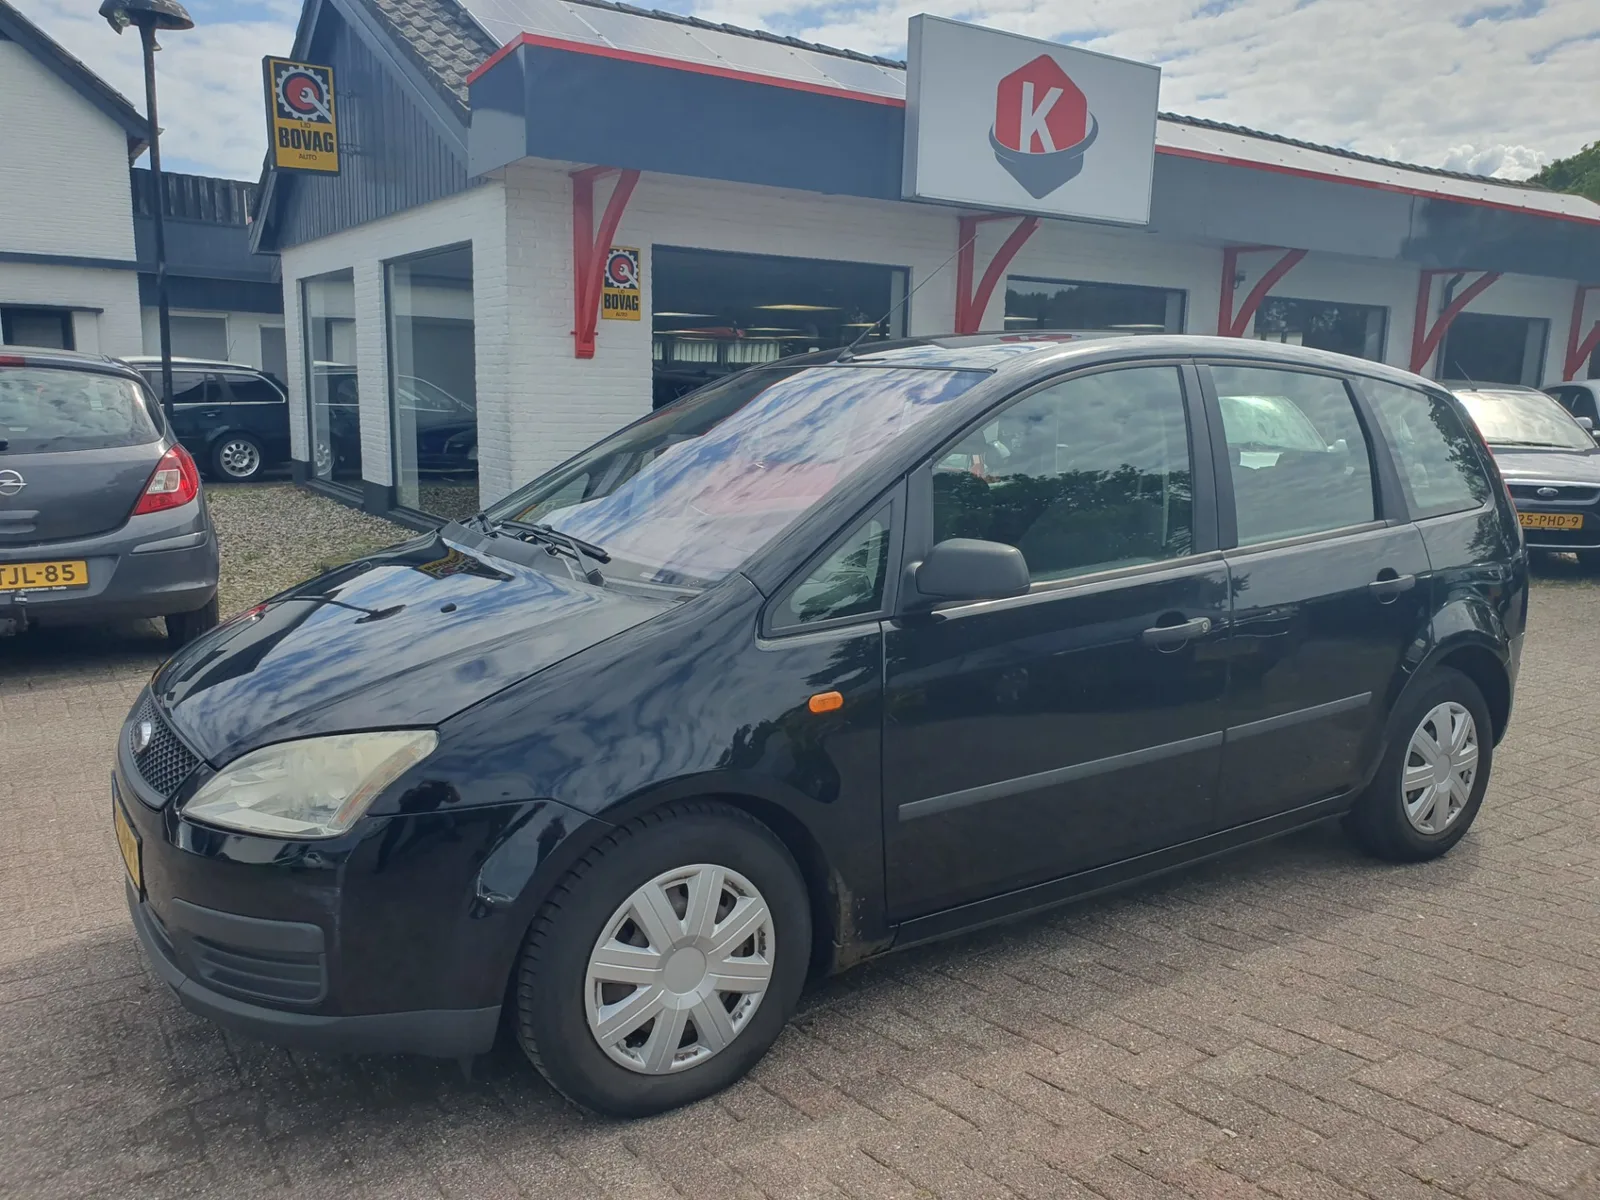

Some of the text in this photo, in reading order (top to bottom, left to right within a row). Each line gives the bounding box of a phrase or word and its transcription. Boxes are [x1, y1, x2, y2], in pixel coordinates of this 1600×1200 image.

[1019, 81, 1064, 153] K
[278, 127, 334, 153] BOVAG
[298, 153, 317, 161] AUTO
[604, 293, 639, 311] BOVAG
[1518, 514, 1579, 527] 25-PHD-9
